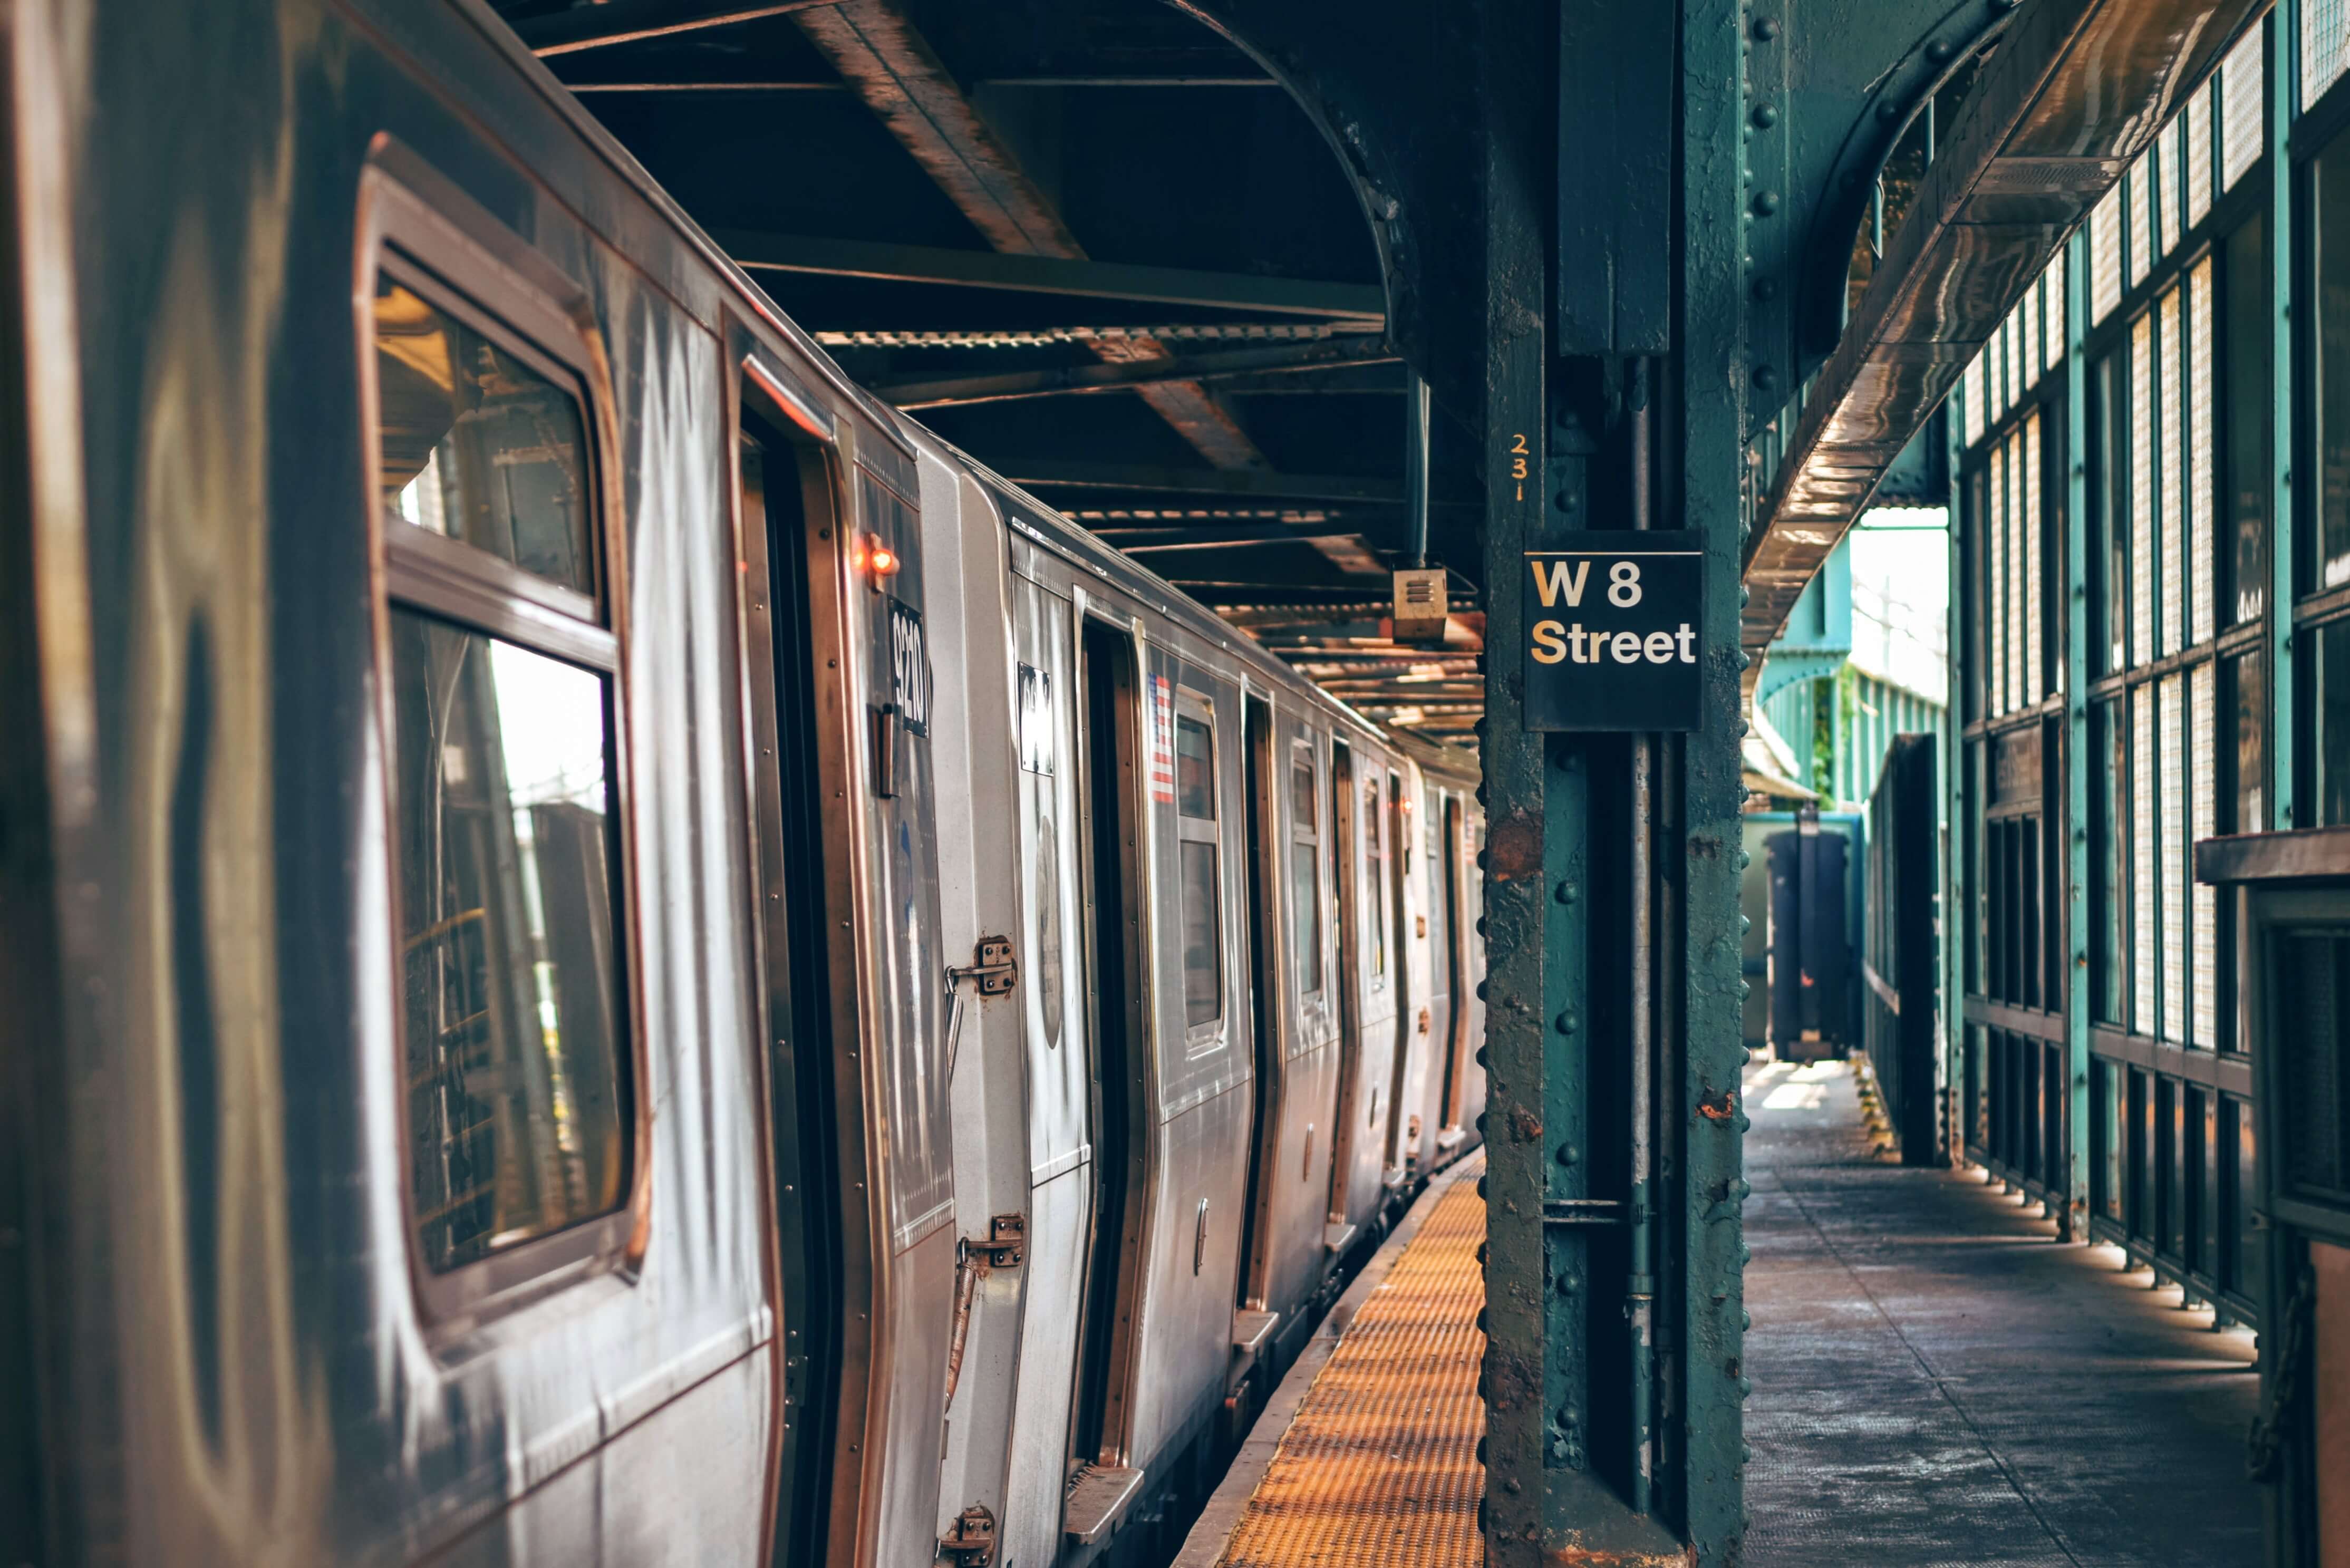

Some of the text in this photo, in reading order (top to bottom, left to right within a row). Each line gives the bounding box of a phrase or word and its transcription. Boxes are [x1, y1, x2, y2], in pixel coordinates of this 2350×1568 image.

[1511, 434, 1529, 501] 231
[1531, 561, 1642, 607] W 8
[893, 611, 924, 723] 9210
[1531, 620, 1696, 664] Street
